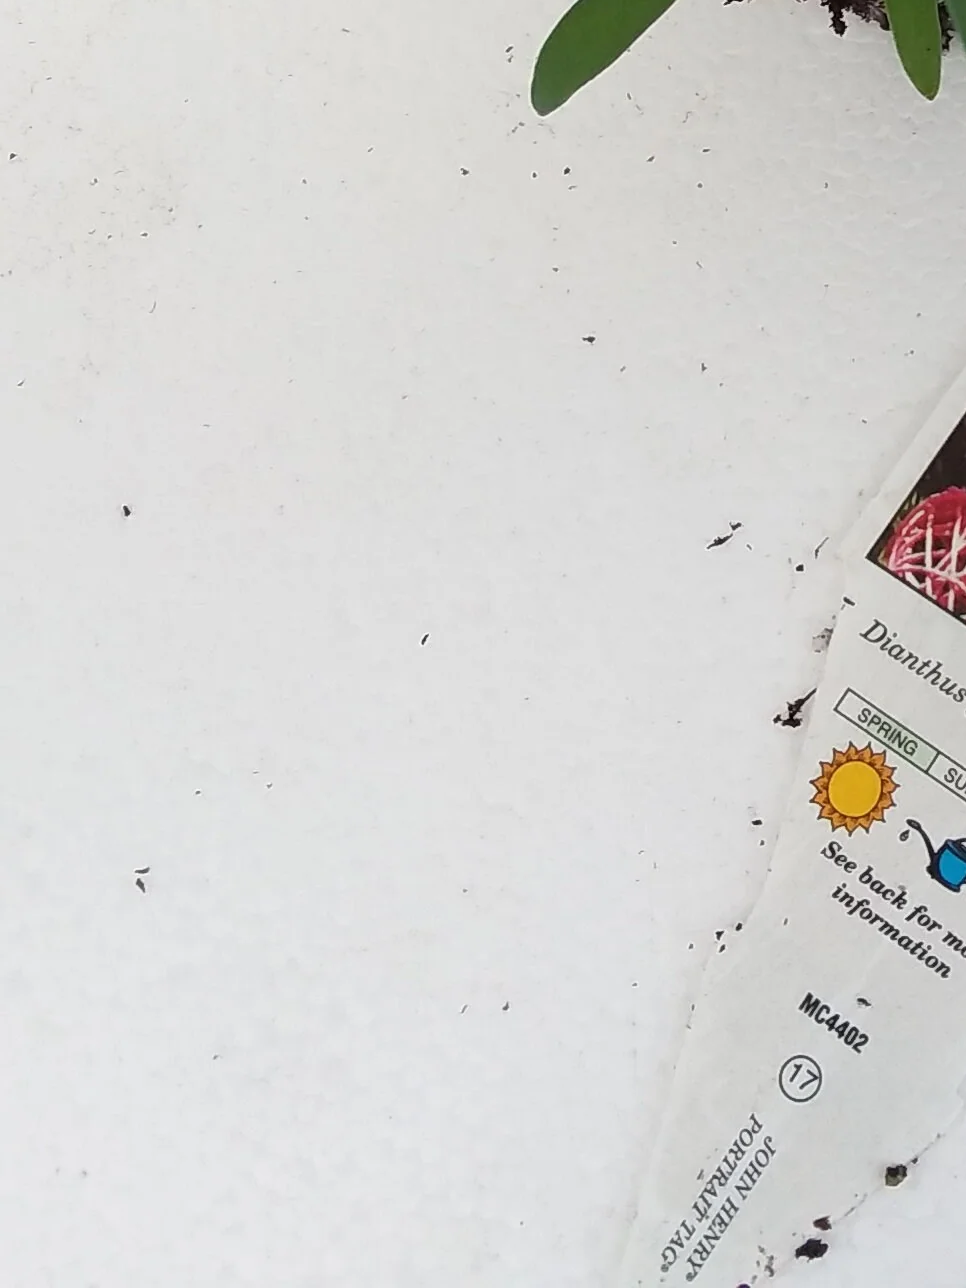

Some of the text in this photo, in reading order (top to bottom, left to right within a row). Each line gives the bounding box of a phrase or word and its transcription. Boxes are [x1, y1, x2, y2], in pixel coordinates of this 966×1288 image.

[857, 708, 918, 757] SPRING
[821, 841, 857, 873] See
[859, 866, 907, 909] back
[905, 905, 942, 931] for
[832, 883, 951, 978] information
[799, 993, 869, 1053] MC4402
[789, 1064, 819, 1089] 17
[692, 1114, 762, 1222] PORTRAIT
[735, 1136, 776, 1200] JOHN
